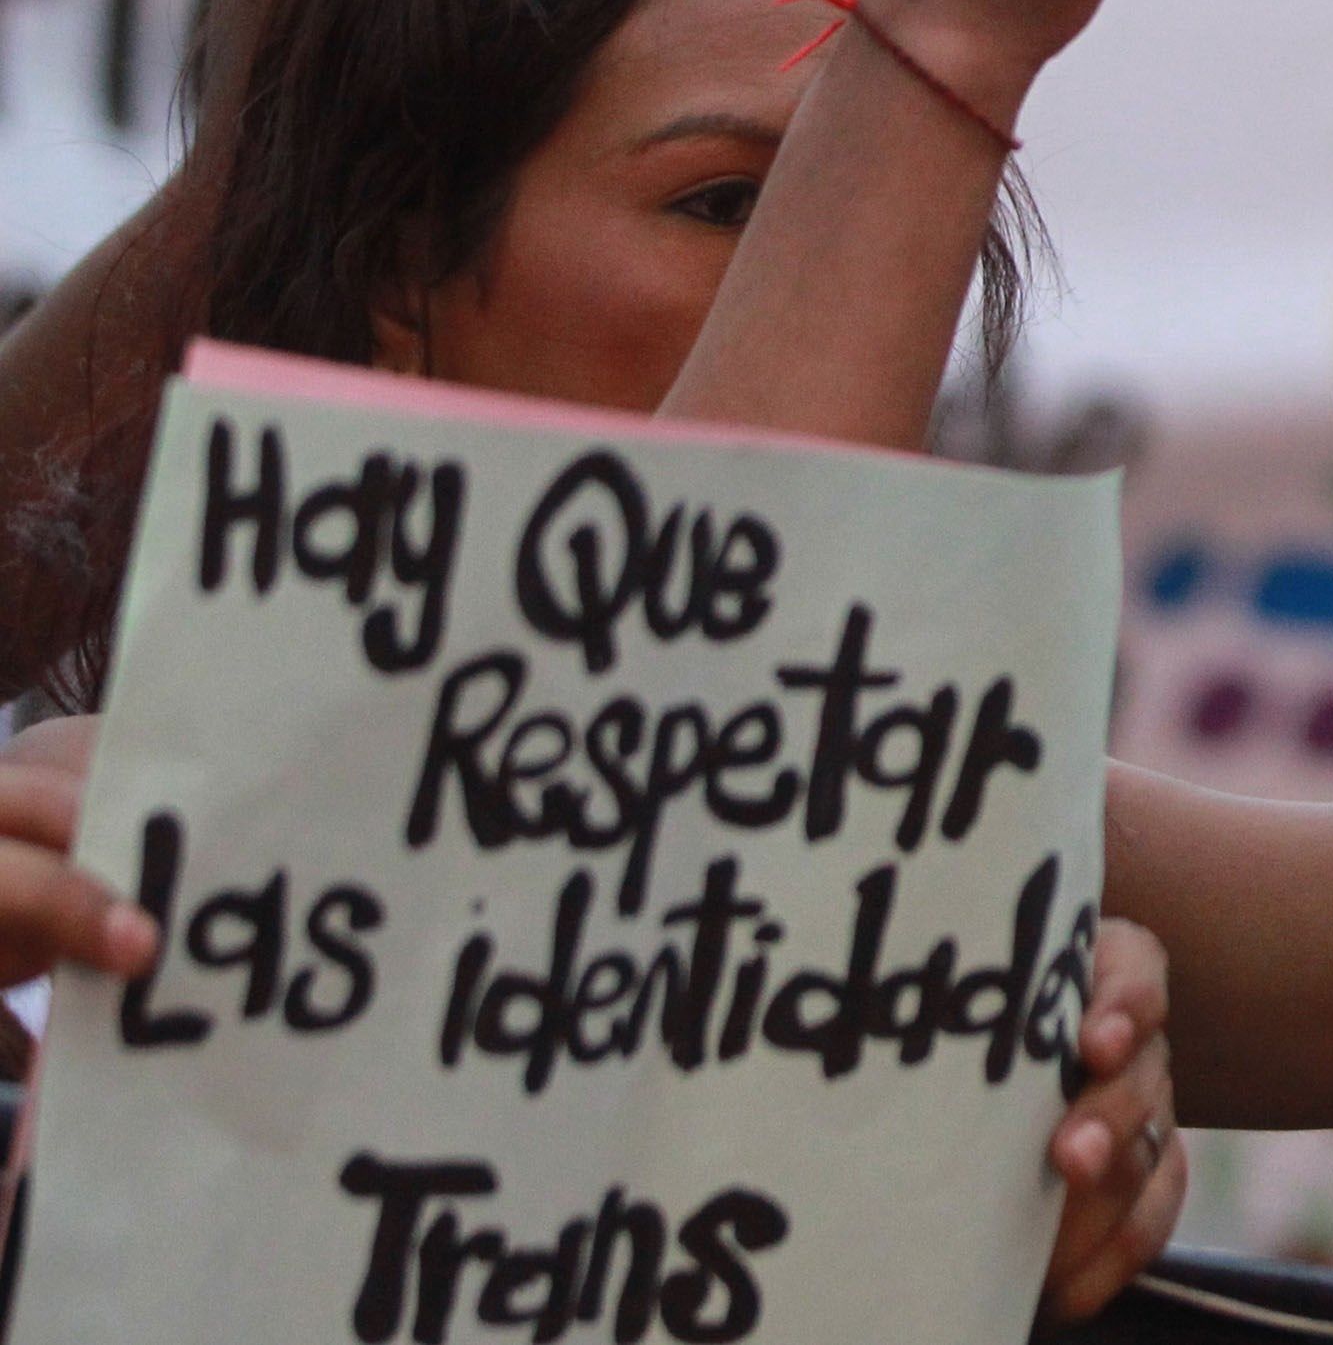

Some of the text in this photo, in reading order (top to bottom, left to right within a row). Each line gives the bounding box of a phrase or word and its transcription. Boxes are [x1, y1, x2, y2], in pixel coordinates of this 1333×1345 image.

[197, 419, 780, 675] Hay Que
[404, 602, 1043, 917] Respetar
[116, 811, 384, 1049] Las
[338, 1150, 790, 1345] Trans
